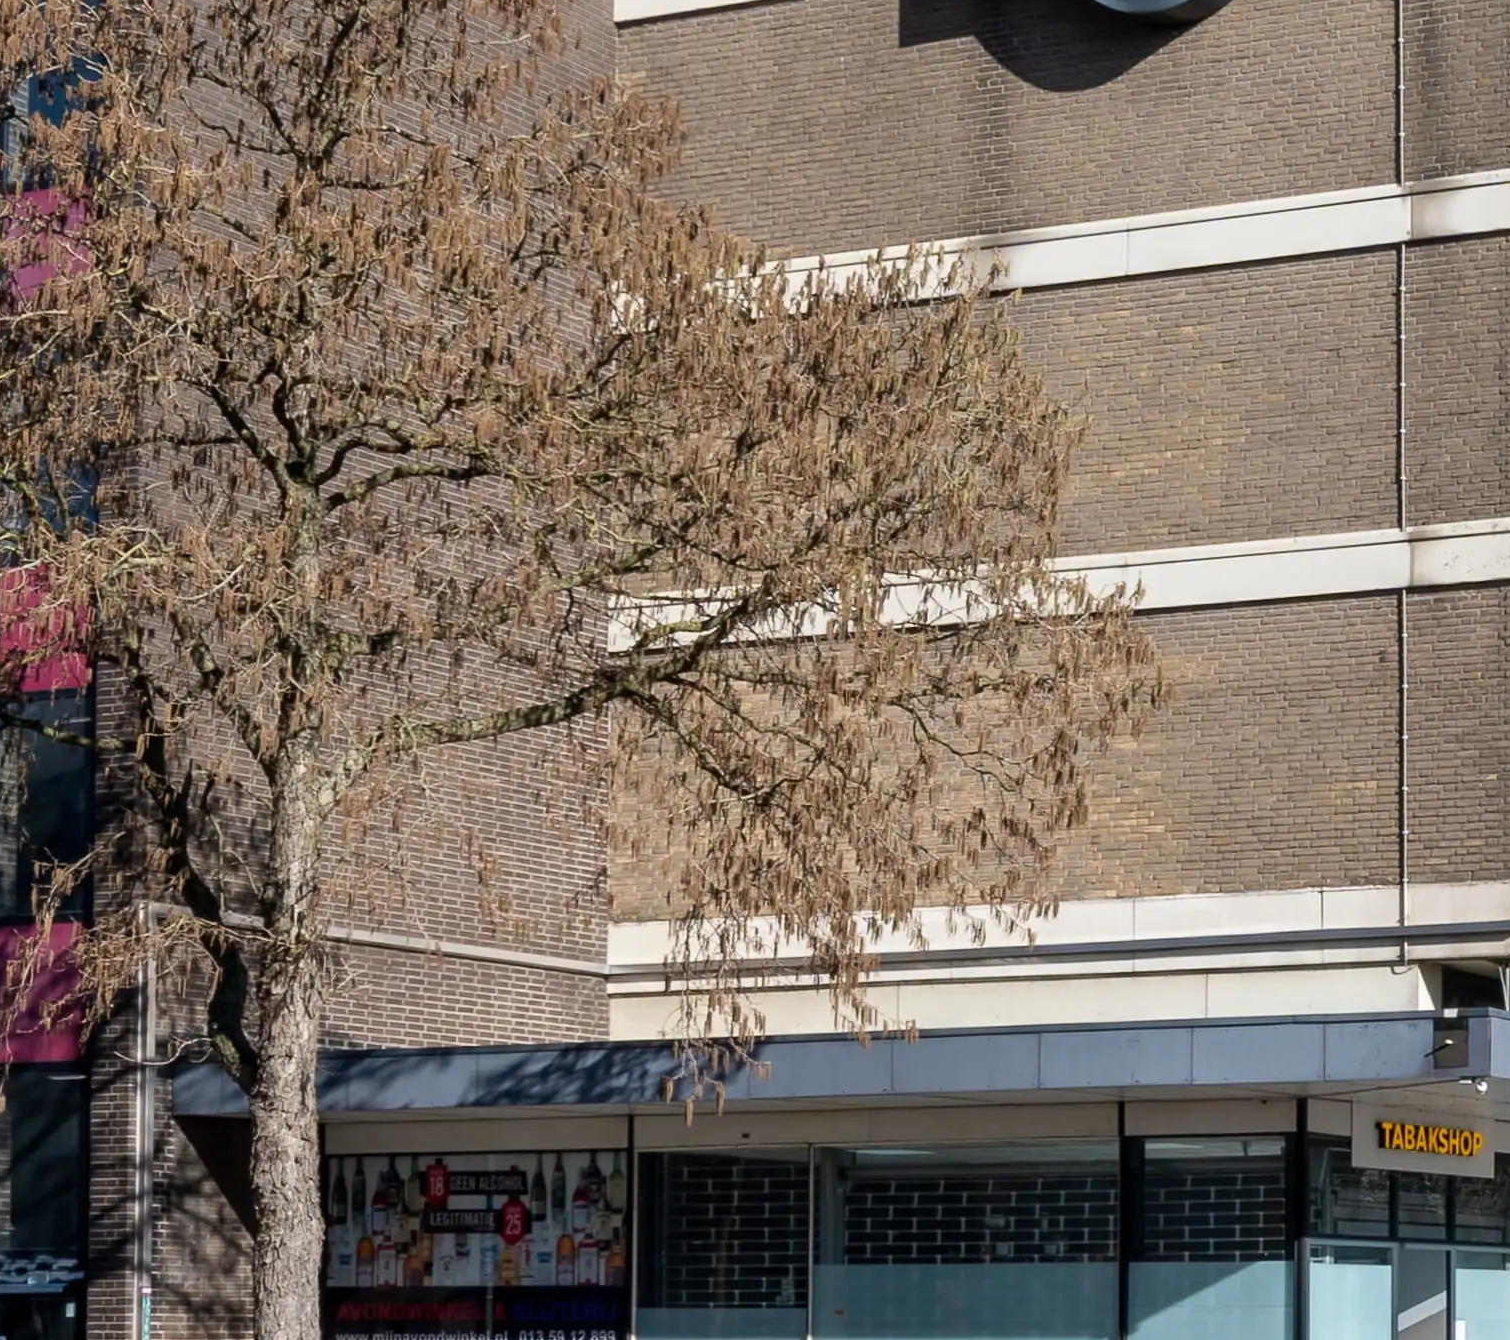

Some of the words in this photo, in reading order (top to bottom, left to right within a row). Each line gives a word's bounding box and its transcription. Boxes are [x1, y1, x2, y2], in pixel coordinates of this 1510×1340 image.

[1379, 1120, 1484, 1158] TABAKSHOP
[429, 1176, 444, 1196] 18
[449, 1176, 477, 1191] GEEN
[478, 1175, 524, 1190] ALCOHOL
[430, 1212, 496, 1227] LEGITIMATIE
[505, 1214, 522, 1235] 25
